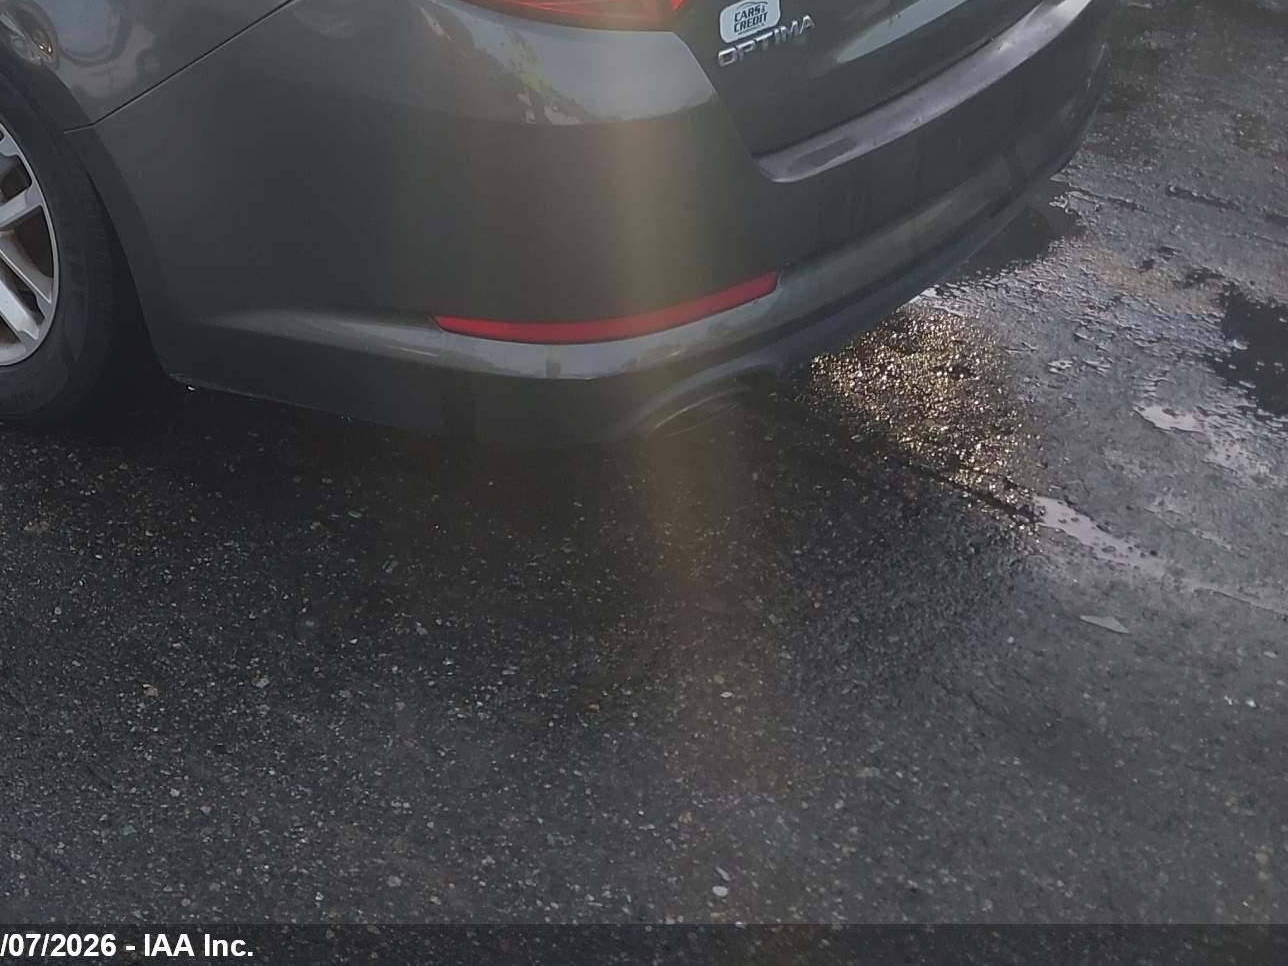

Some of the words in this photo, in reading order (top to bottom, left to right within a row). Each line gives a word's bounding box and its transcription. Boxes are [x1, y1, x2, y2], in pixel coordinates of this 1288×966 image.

[734, 4, 761, 23] CARS
[734, 12, 768, 33] CREDIT
[718, 14, 815, 67] OPTIMA
